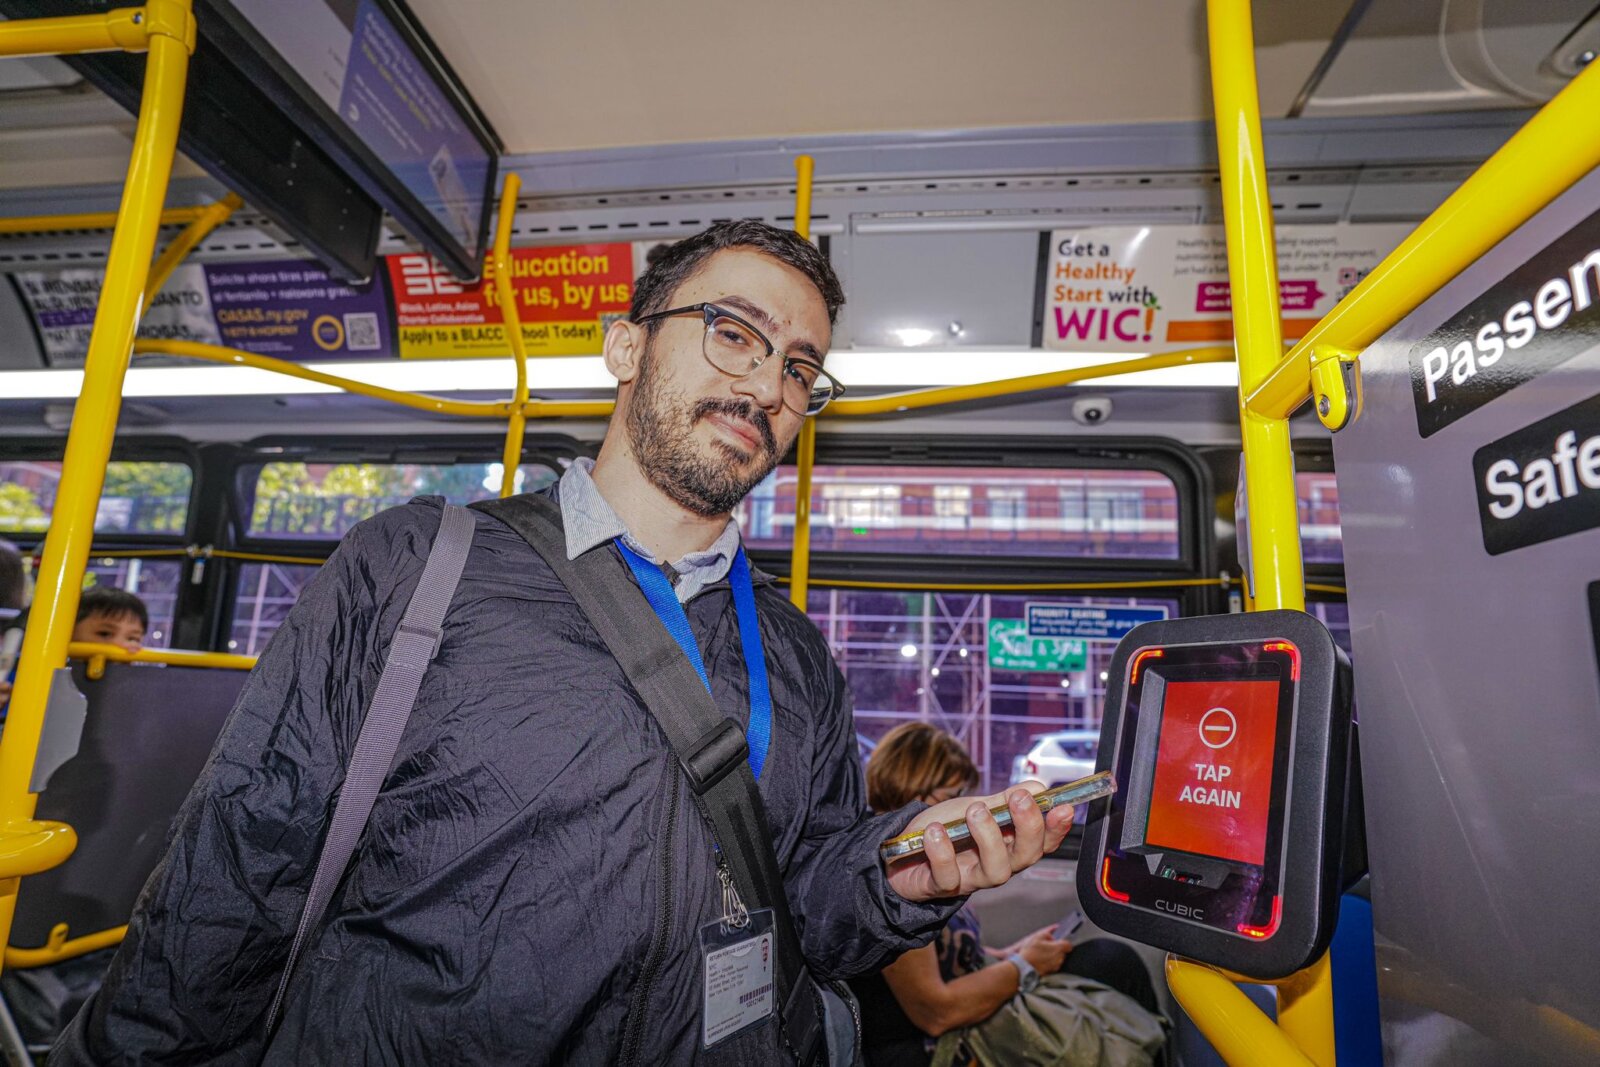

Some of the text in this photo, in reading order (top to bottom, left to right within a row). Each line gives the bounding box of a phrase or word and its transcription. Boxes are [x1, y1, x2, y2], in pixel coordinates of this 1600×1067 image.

[1058, 239, 1110, 257] Get a
[1055, 262, 1136, 285] Healthy
[522, 286, 560, 309] us,
[563, 280, 597, 310] by
[599, 284, 631, 304] us
[1054, 284, 1154, 304] Start with
[402, 325, 597, 345] Apply to a BLACC hool Today!
[1053, 304, 1156, 343] WIC!
[1422, 249, 1600, 403] Passen
[1485, 430, 1600, 520] Safe
[1195, 763, 1231, 782] TAP
[1179, 786, 1241, 809] AGAIN
[1155, 899, 1204, 920] CUBIC
